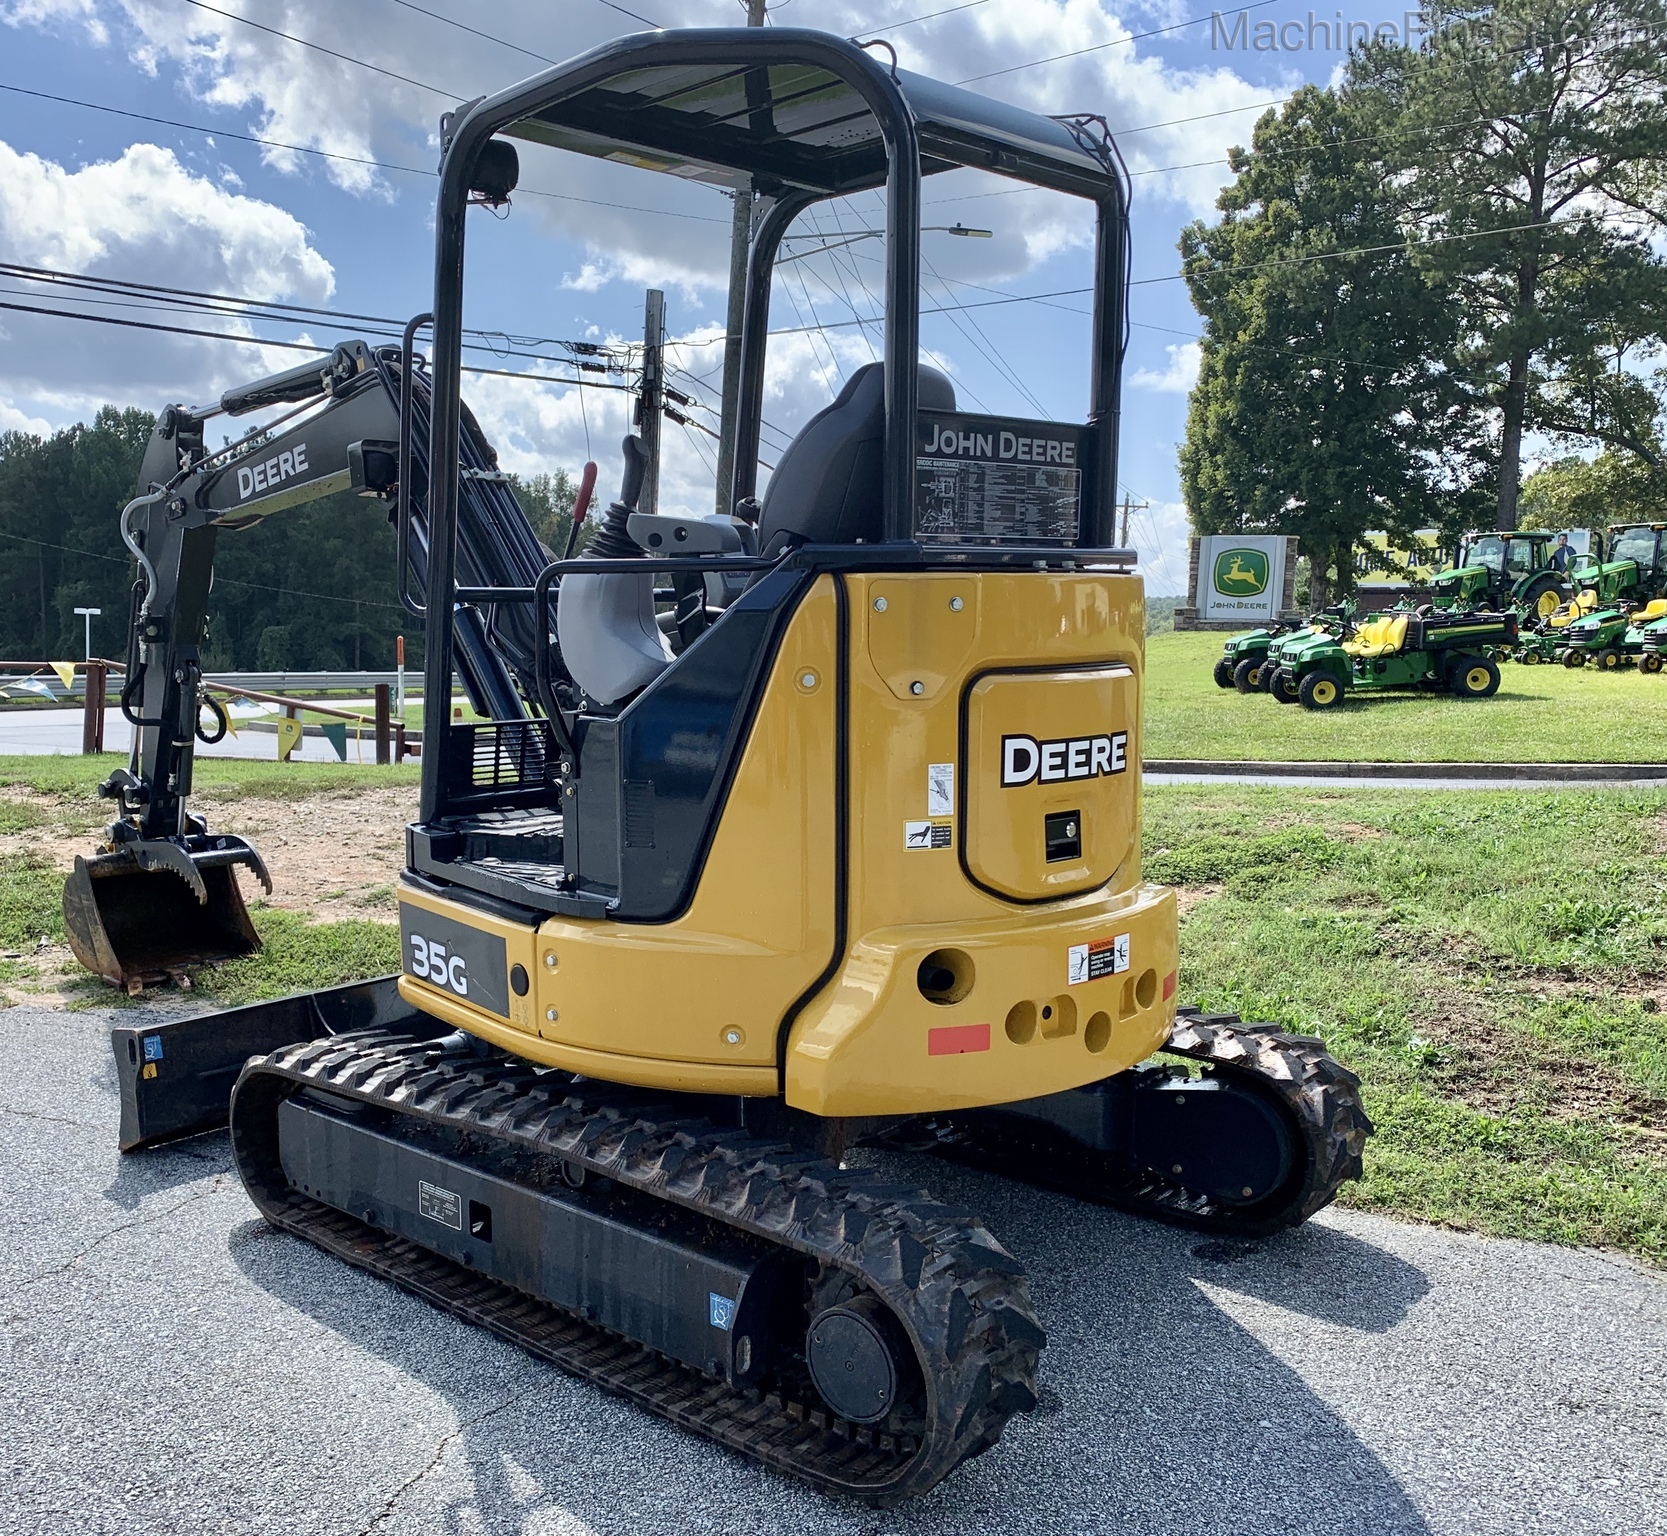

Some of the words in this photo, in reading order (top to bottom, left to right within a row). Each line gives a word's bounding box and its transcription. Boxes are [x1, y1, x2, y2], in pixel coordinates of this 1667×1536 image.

[925, 424, 993, 457] JOHN
[999, 431, 1076, 464] DEERE
[237, 443, 309, 500] DEERE
[1210, 601, 1236, 609] JOHN
[1237, 601, 1268, 610] DEERE
[1003, 734, 1127, 784] DEERE
[410, 934, 468, 995] 35G
